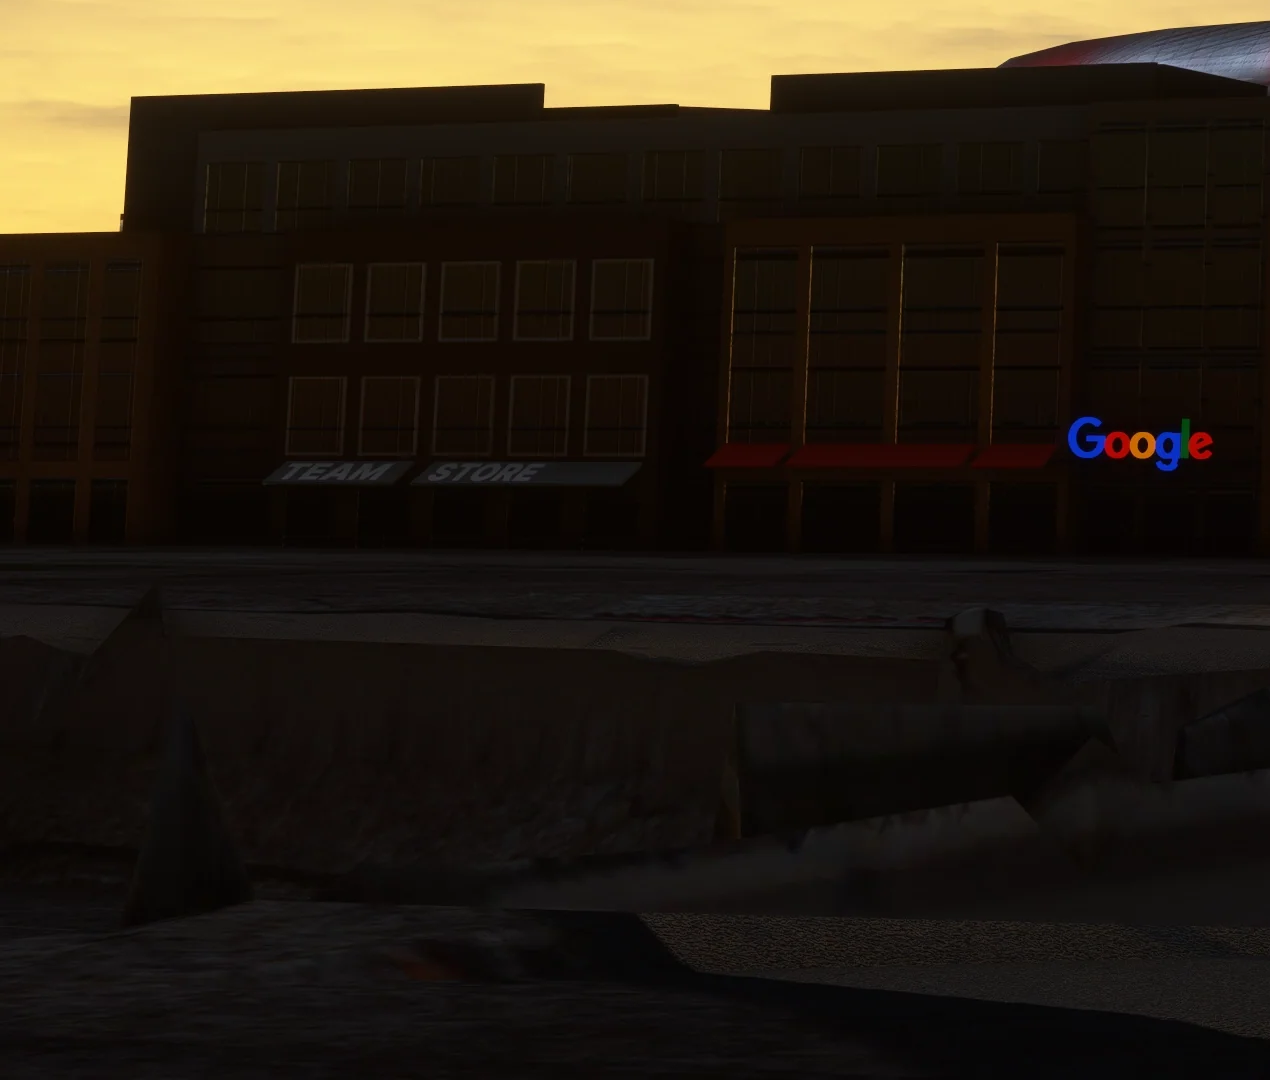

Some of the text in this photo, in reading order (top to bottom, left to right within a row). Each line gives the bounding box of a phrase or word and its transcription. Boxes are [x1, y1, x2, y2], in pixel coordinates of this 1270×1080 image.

[1067, 416, 1214, 471] Google
[281, 462, 546, 482] TEAM STORE
